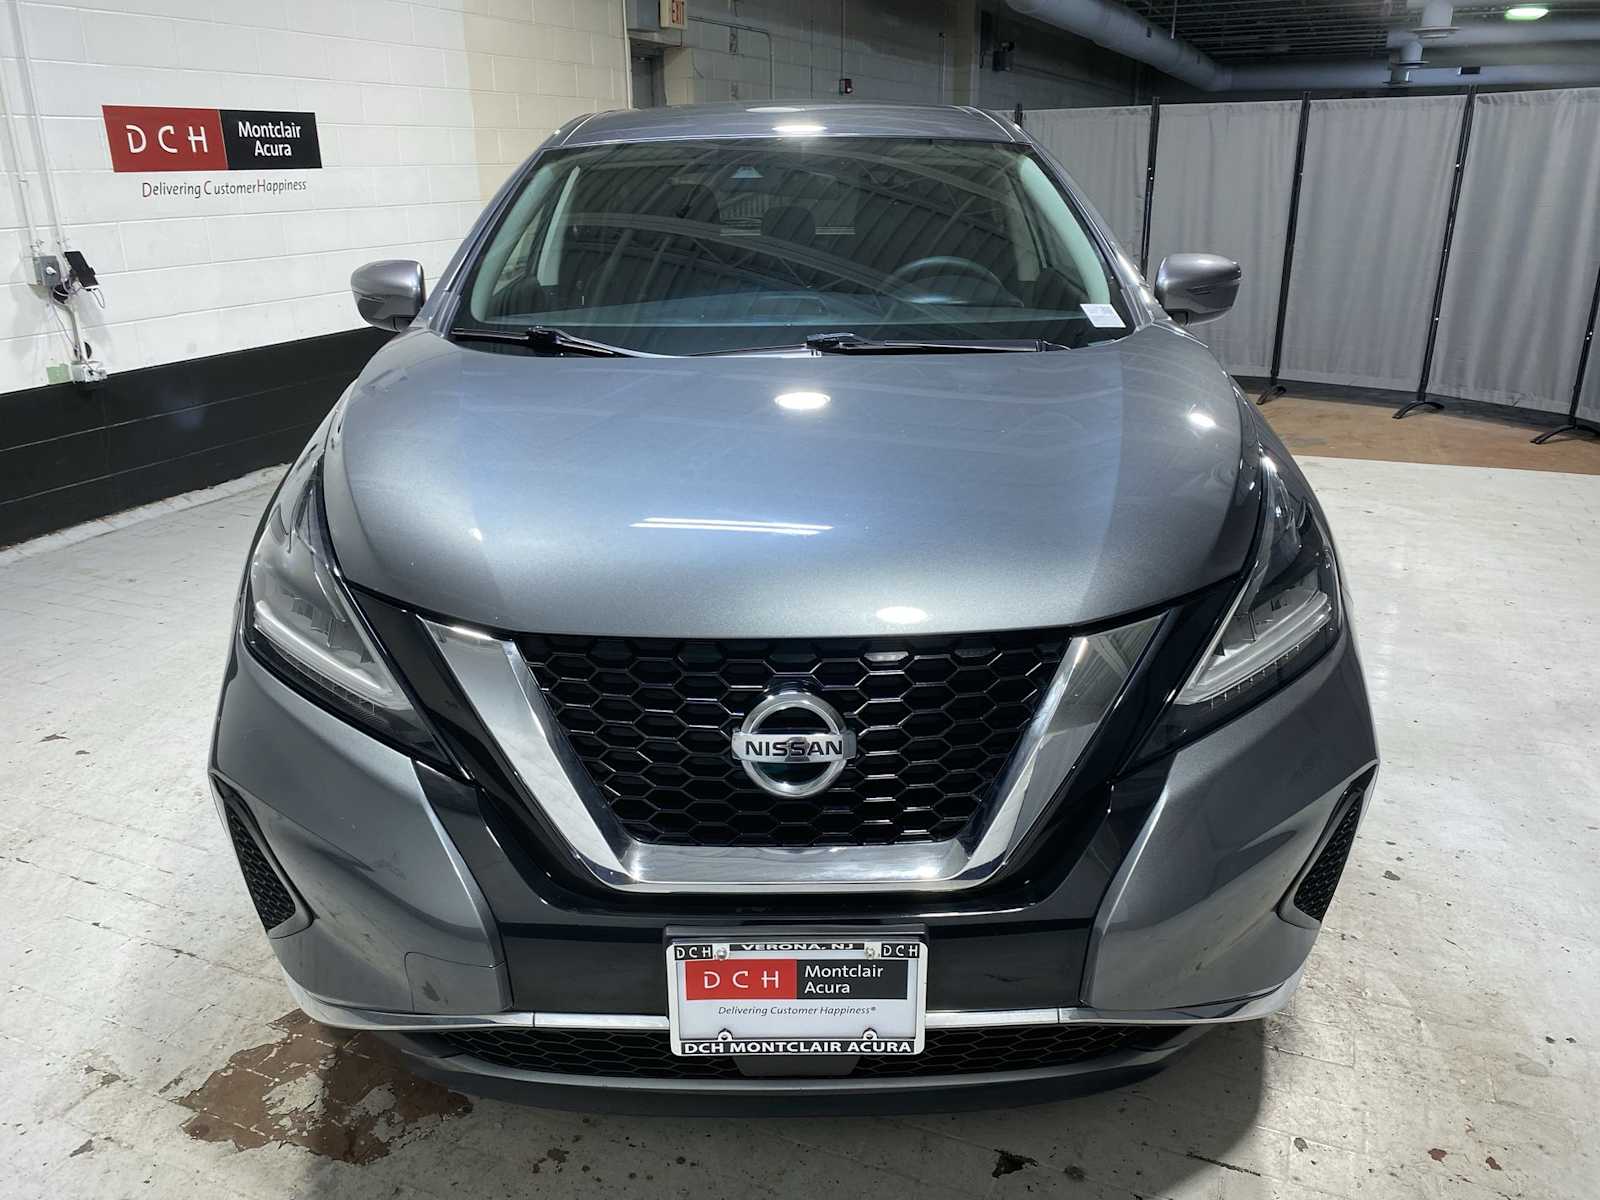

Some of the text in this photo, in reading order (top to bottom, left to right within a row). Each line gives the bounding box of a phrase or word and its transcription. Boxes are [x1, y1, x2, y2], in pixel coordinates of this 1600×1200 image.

[238, 121, 301, 139] Montclair
[125, 124, 208, 154] DCH
[254, 140, 292, 157] Acura
[142, 182, 200, 198] Delivering
[257, 179, 306, 194] Happiness
[745, 740, 843, 756] NISSAN
[676, 947, 712, 959] DCH
[883, 945, 918, 957] DCH
[804, 965, 884, 978] Montclair
[703, 970, 780, 989] DCH
[804, 981, 850, 994] Acura
[718, 1006, 768, 1016] Delivering
[770, 1006, 817, 1015] Customer
[684, 1042, 912, 1054] DCH MONTCLAIR ACURA
